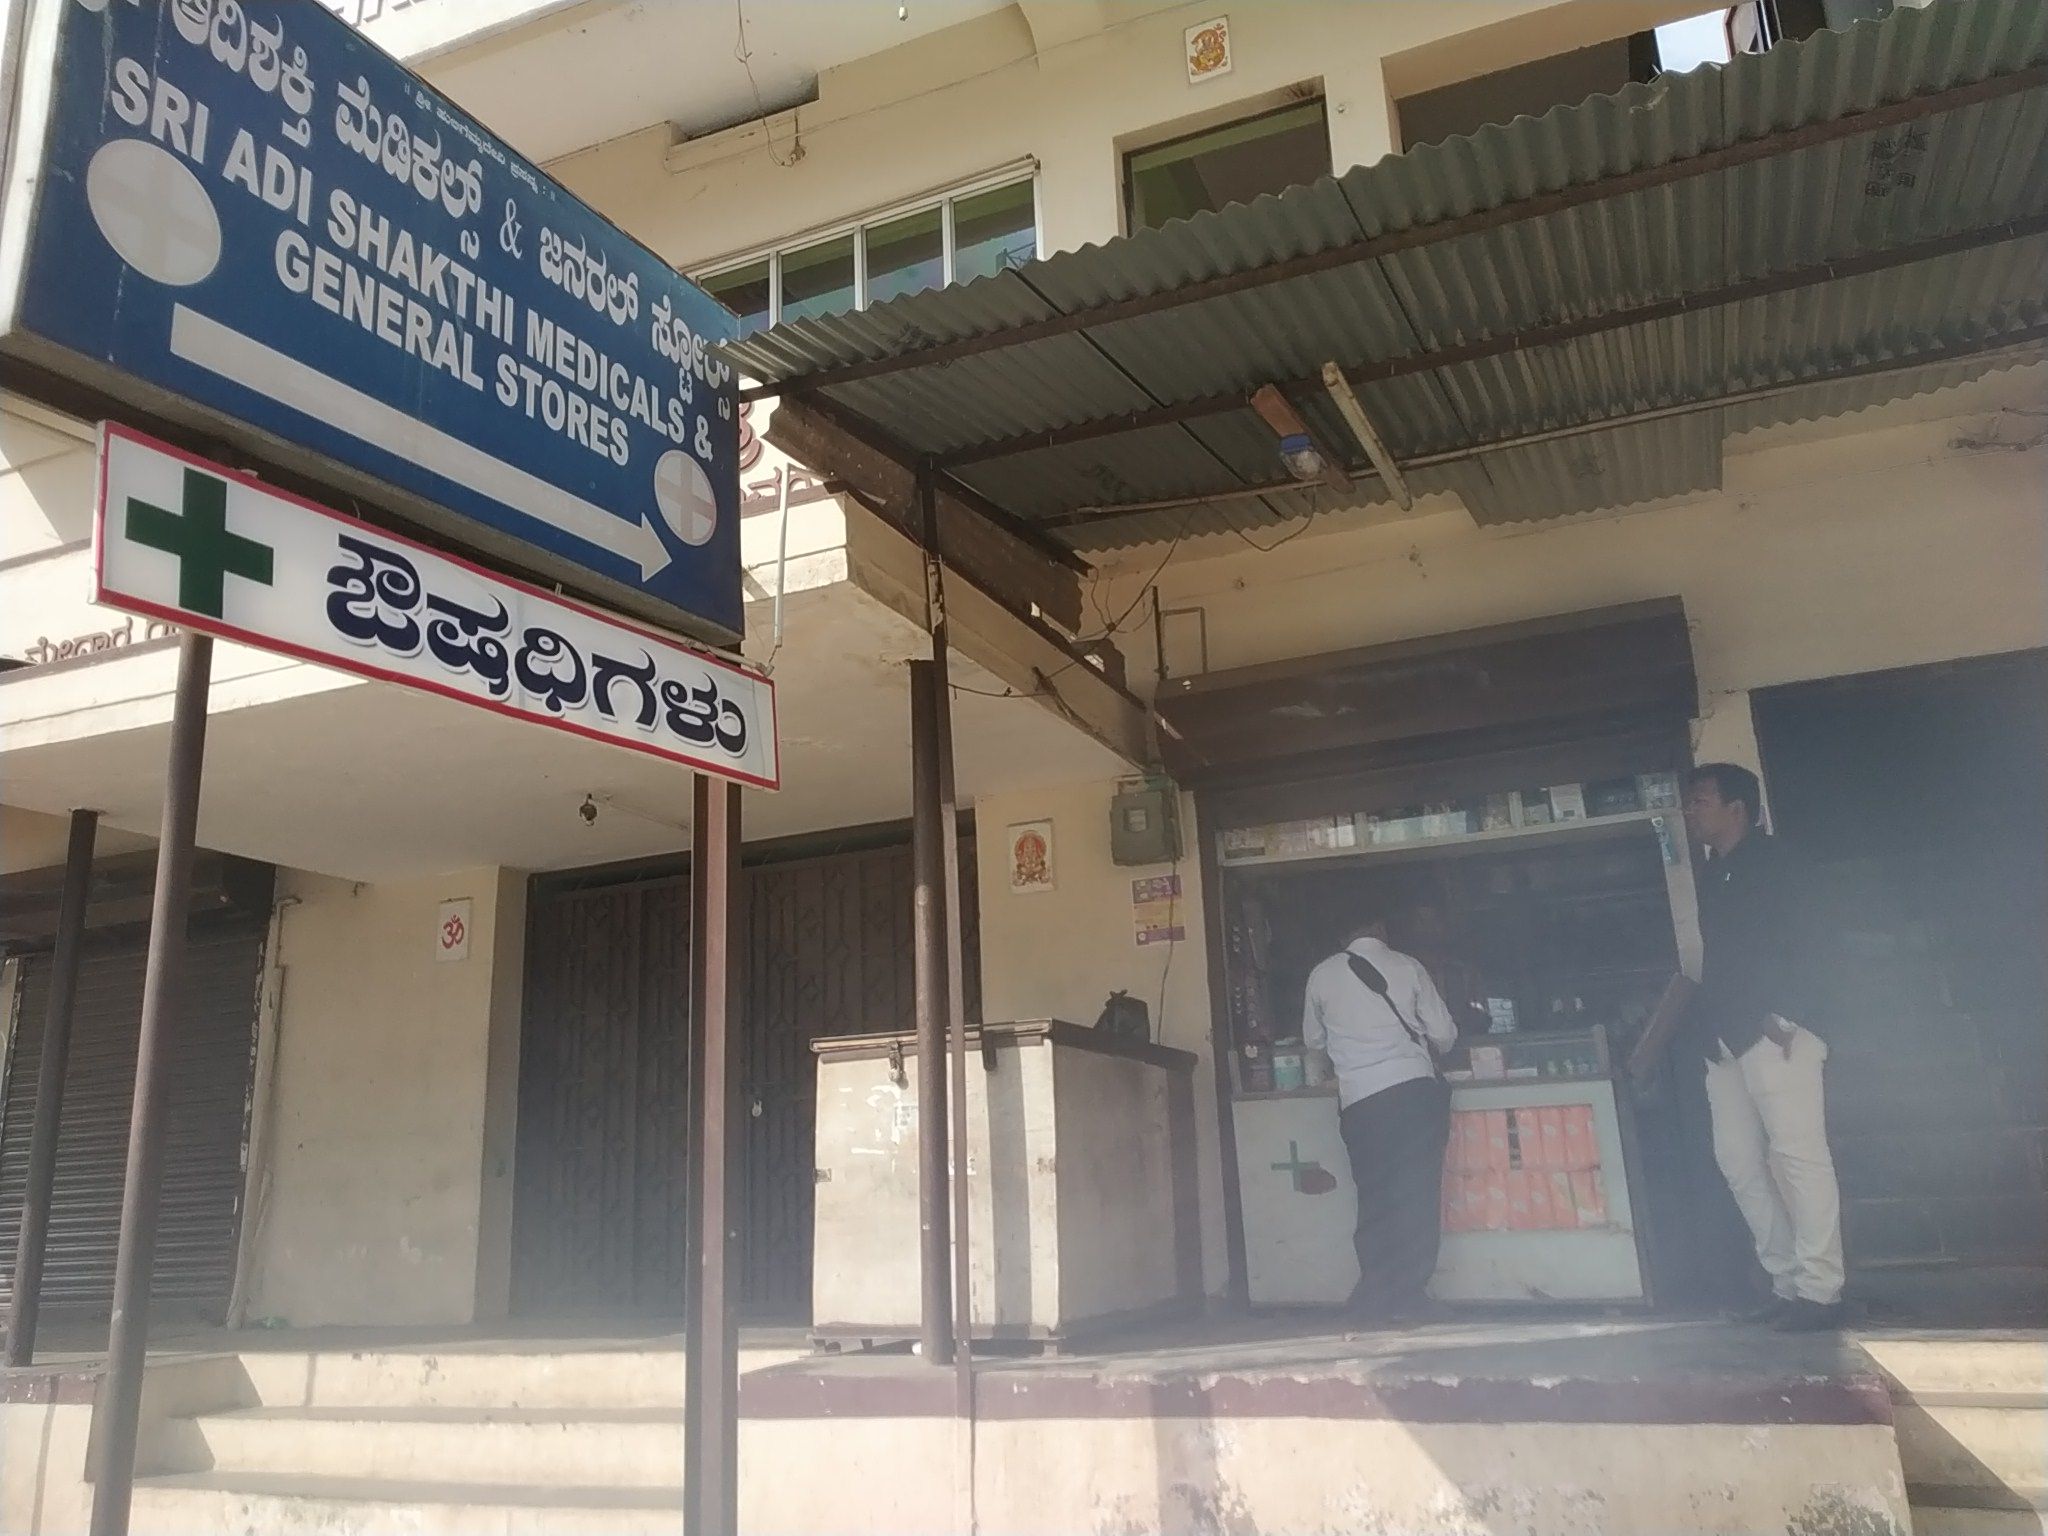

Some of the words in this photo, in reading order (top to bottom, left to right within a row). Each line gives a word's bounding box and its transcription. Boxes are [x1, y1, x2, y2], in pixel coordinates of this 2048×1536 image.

[111, 56, 209, 164] SRI
[222, 127, 313, 227] ADI
[327, 188, 513, 345] SHAKTHI
[526, 308, 685, 444] MEDICALS
[693, 414, 714, 463] &
[275, 229, 484, 392] GENERAL
[494, 353, 629, 466] STORES
[500, 198, 523, 260] &
[539, 226, 639, 326] ಜನರಲ್
[326, 533, 747, 758] ಔಷಧಿಗಳು
